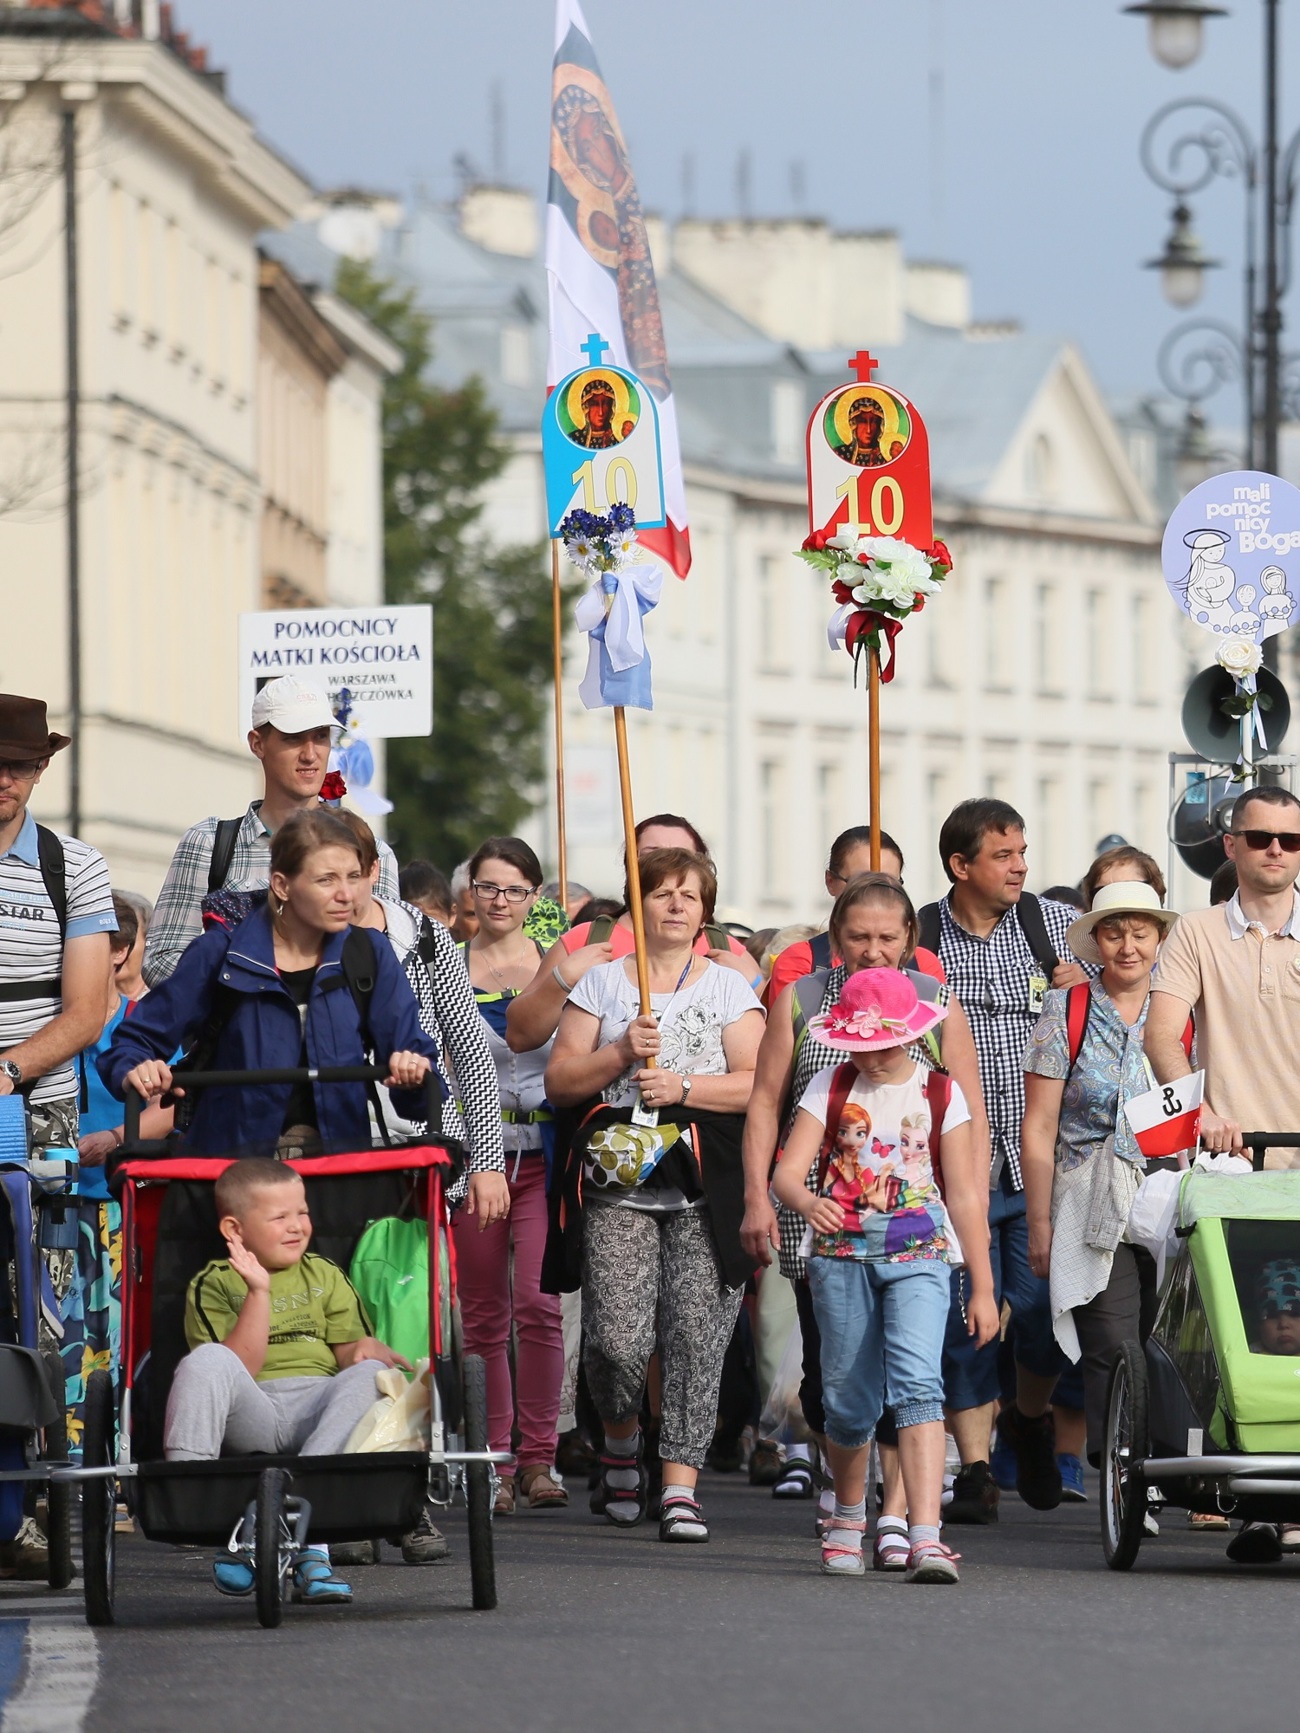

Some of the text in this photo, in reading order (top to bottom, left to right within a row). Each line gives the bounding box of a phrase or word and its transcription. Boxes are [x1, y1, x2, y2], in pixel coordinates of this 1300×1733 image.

[571, 456, 638, 512] 10
[1233, 482, 1270, 502] mali
[836, 475, 904, 535] 10
[1206, 501, 1271, 520] pomoc
[1234, 514, 1270, 535] nicy
[274, 618, 398, 640] POMOCNICY
[250, 641, 420, 668] MATKI KOŚCIOŁA
[327, 674, 396, 686] WARSZAWA
